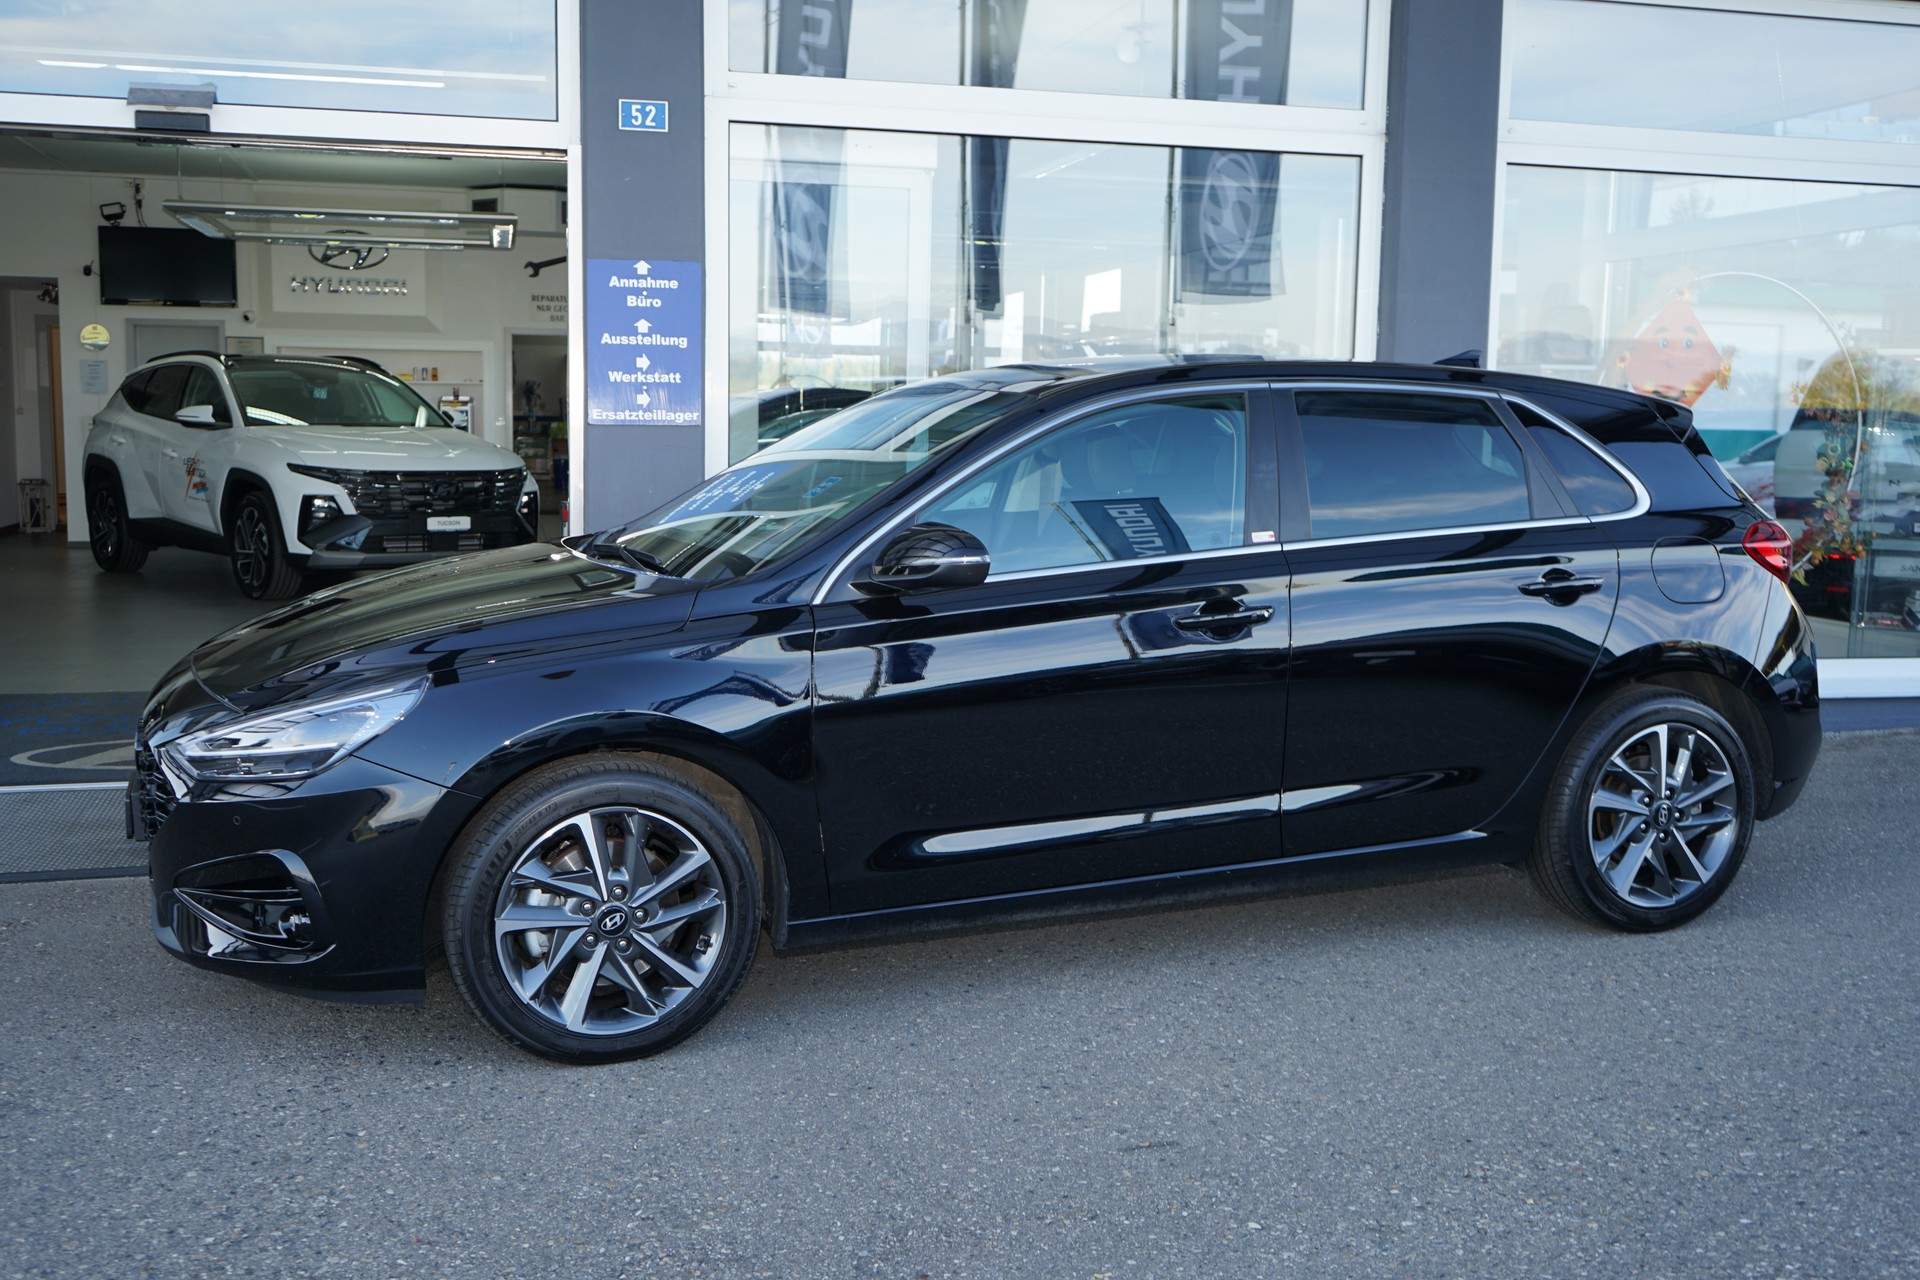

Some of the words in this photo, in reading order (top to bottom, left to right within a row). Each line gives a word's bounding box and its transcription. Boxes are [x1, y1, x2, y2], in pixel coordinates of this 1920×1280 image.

[631, 104, 656, 127] 52
[291, 276, 408, 296] HYUNDAI
[608, 275, 679, 289] Annahme
[626, 295, 662, 308] Büro
[600, 332, 688, 349] Ausstellung
[608, 370, 682, 384] Werkstatt
[591, 408, 700, 423] Ersatzteillager
